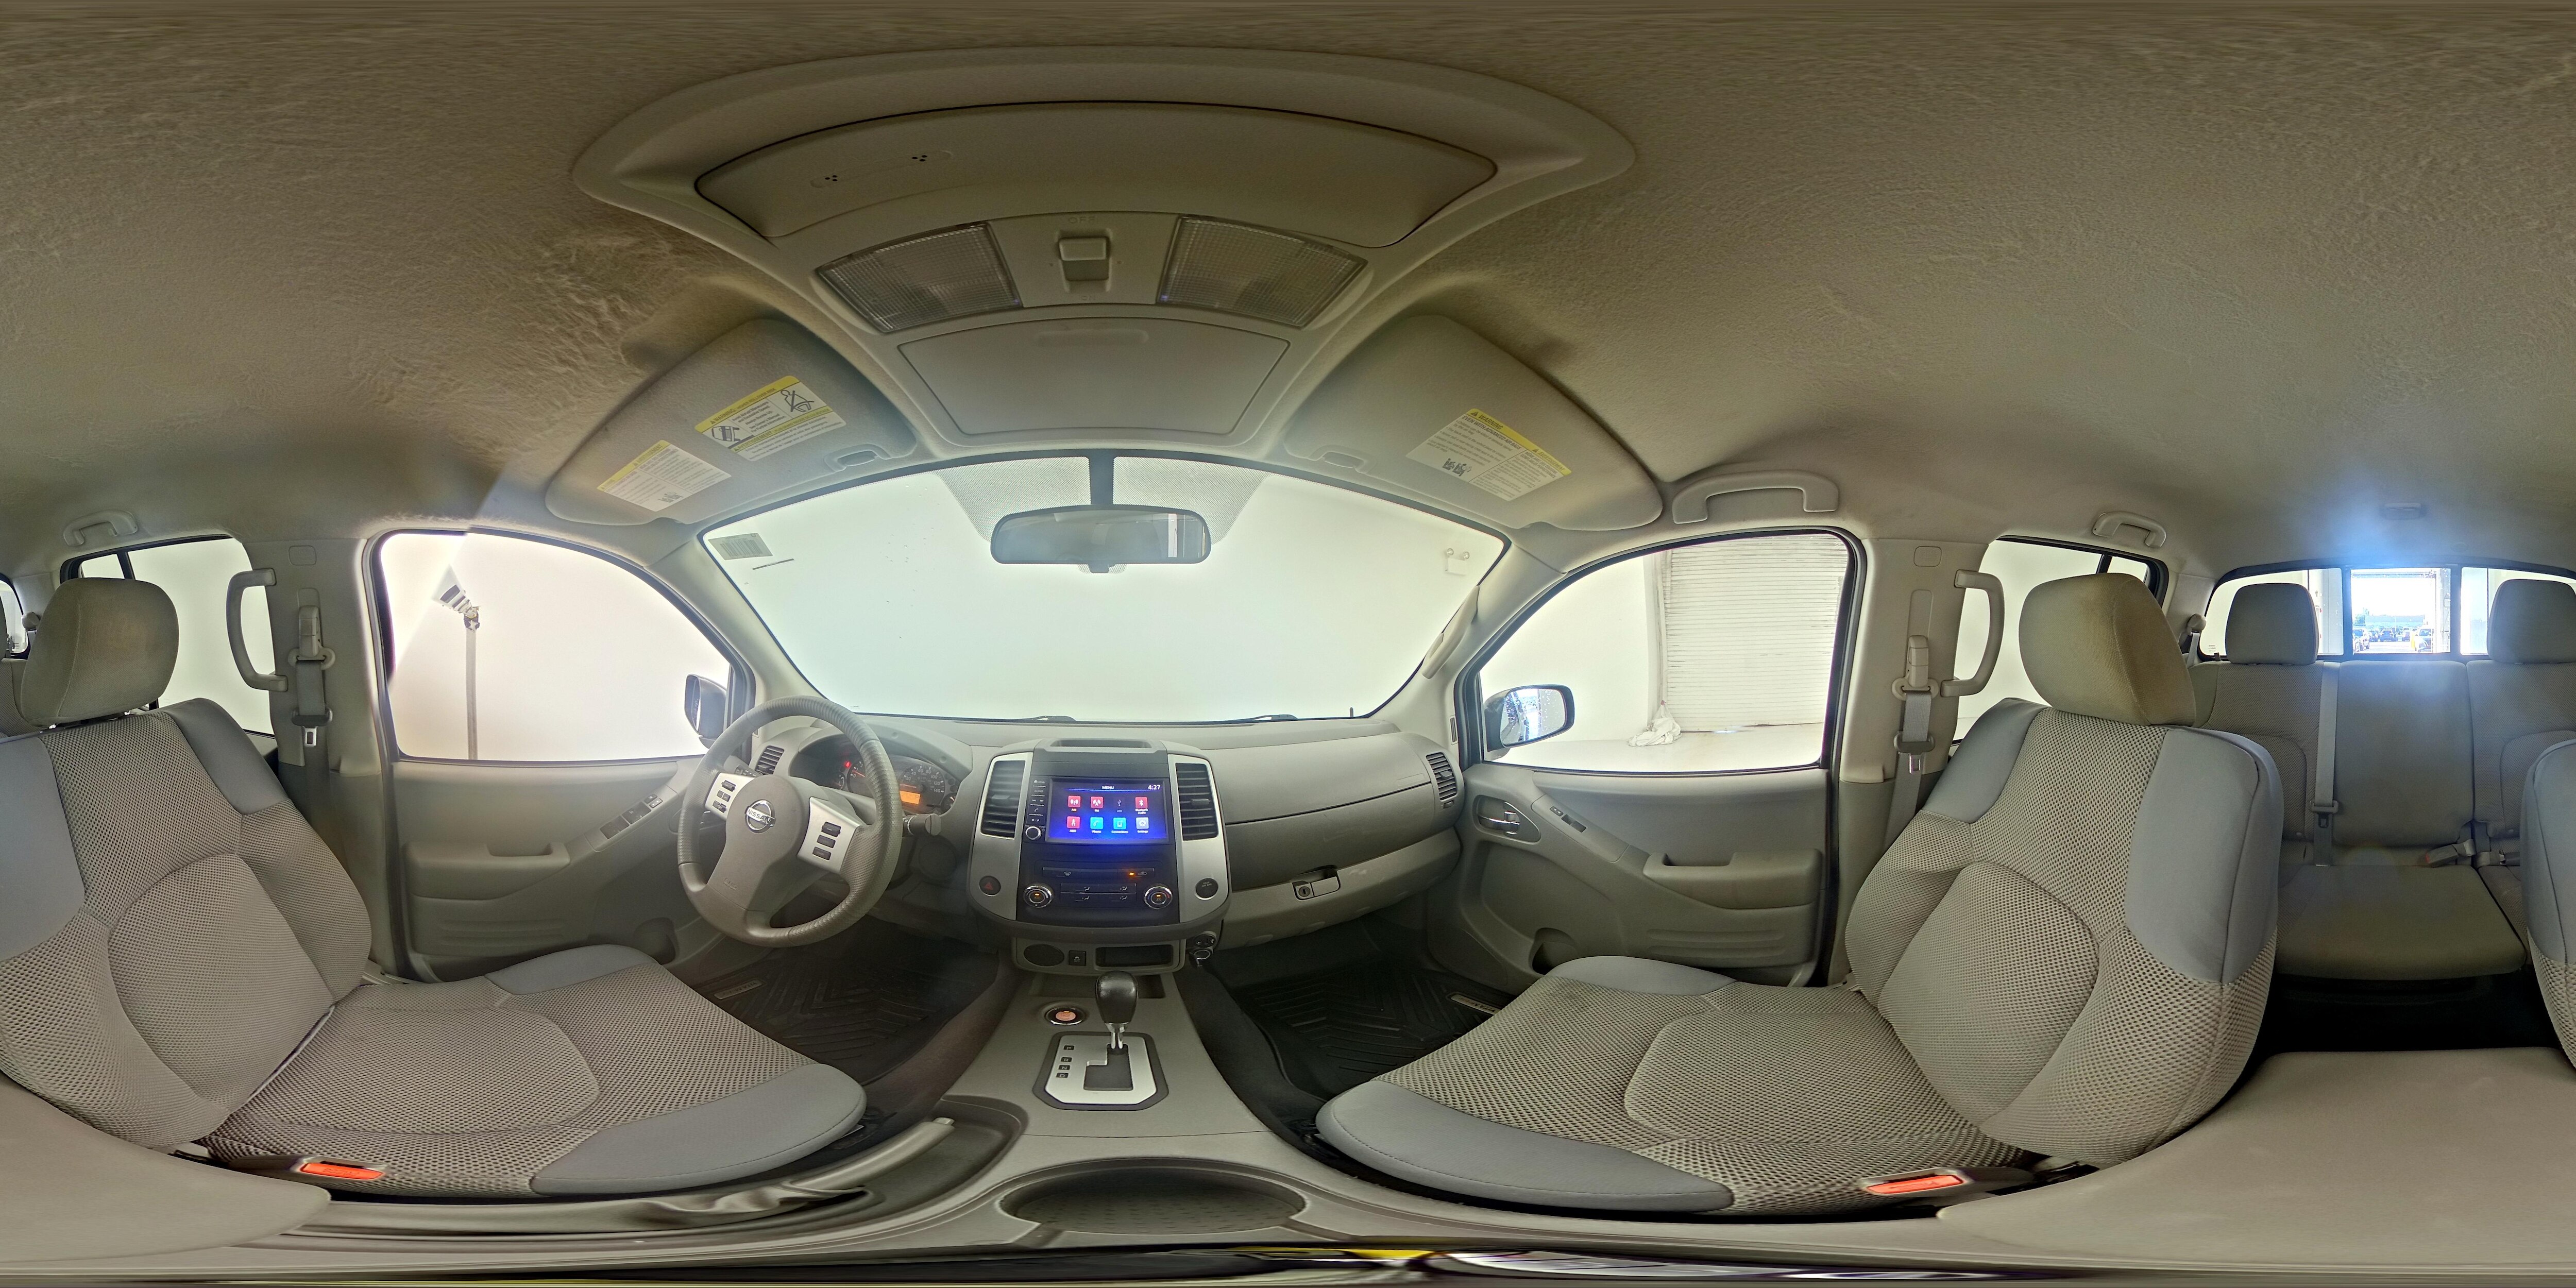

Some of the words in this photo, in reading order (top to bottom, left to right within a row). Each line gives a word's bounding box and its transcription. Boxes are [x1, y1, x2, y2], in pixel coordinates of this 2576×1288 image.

[1461, 415, 1475, 423] EVEN
[1473, 421, 1486, 429] WITH
[1484, 427, 1506, 440] ADVANCED
[1478, 414, 1503, 430] WARNING
[748, 809, 771, 823] NISSAN
